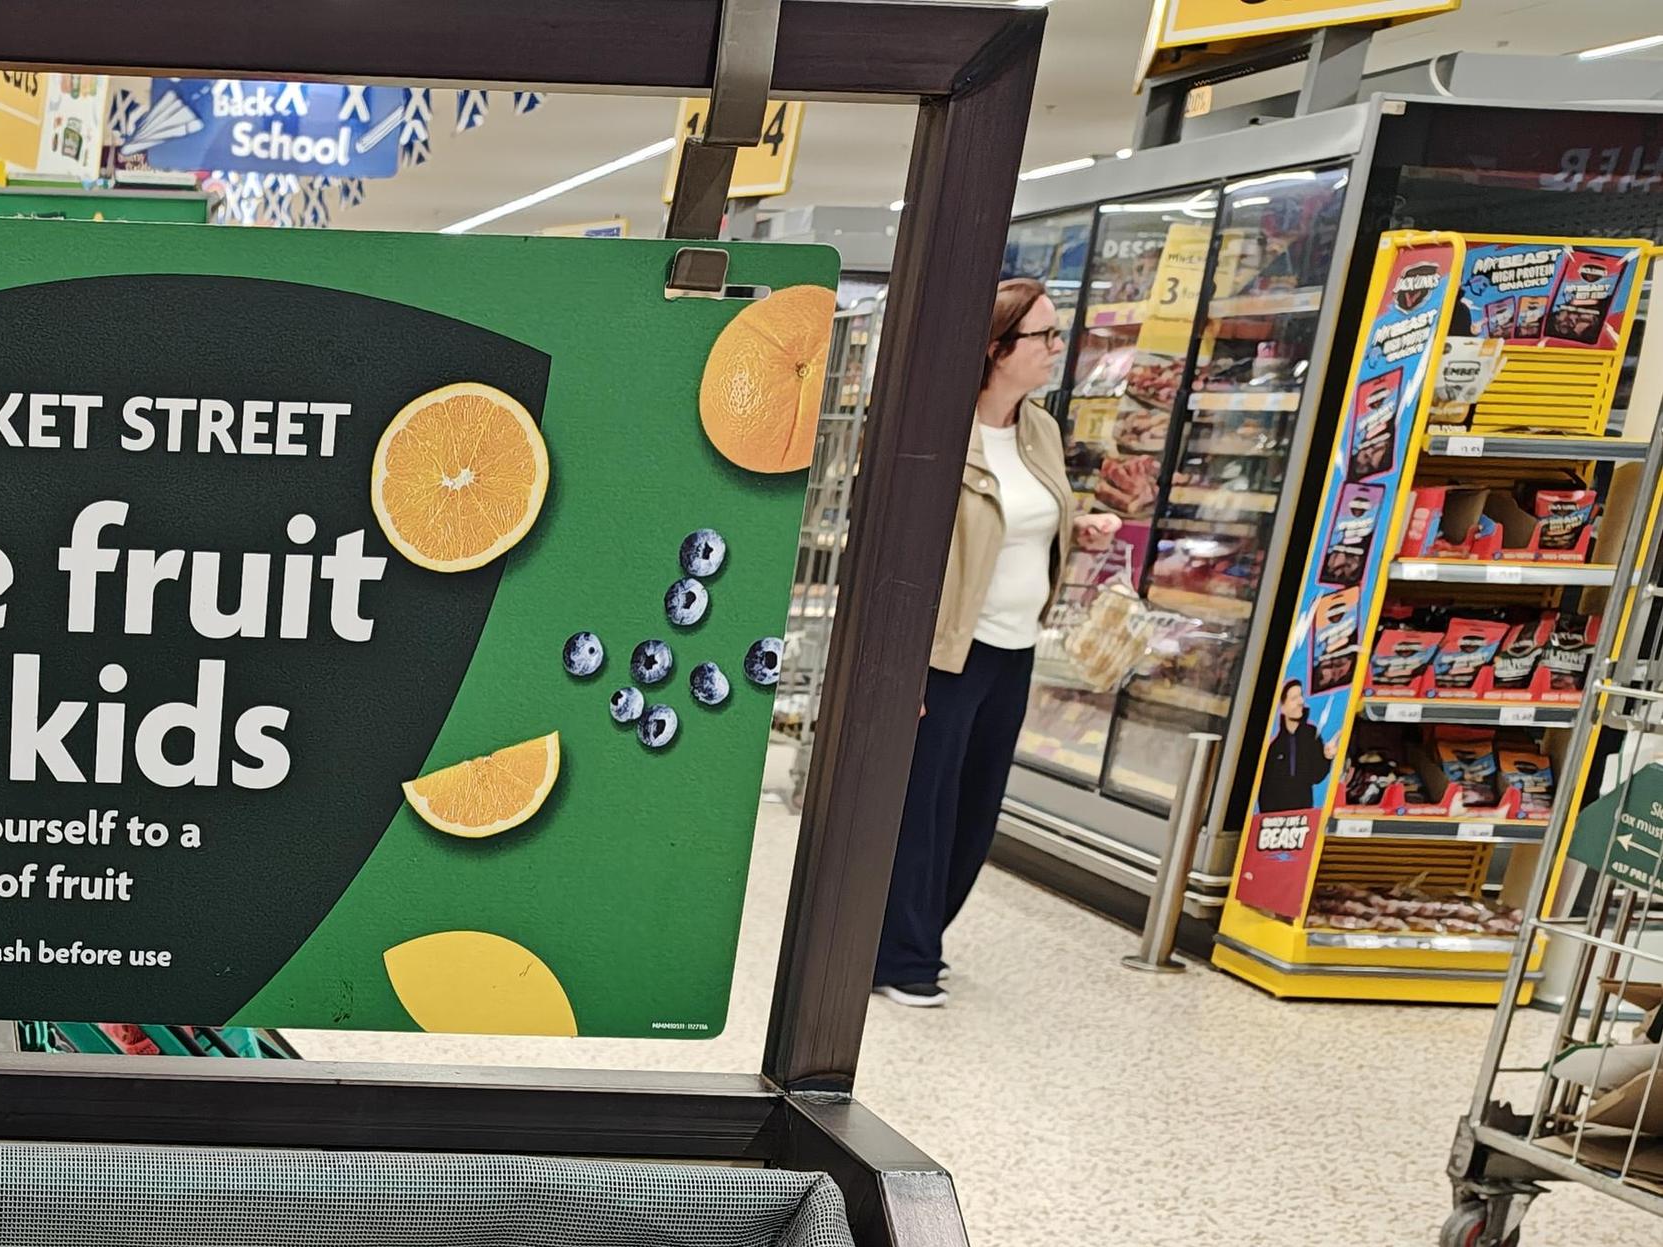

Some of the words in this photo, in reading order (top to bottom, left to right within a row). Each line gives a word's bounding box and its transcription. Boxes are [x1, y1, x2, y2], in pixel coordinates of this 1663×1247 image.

[232, 120, 351, 166] School
[122, 397, 351, 456] STREET
[58, 500, 388, 642] fruit
[10, 654, 290, 788] kids
[127, 816, 168, 846] to
[181, 824, 200, 847] a
[1258, 827, 1310, 850] BEAST
[46, 865, 133, 900] fruit
[39, 940, 121, 964] before
[130, 951, 171, 966] use
